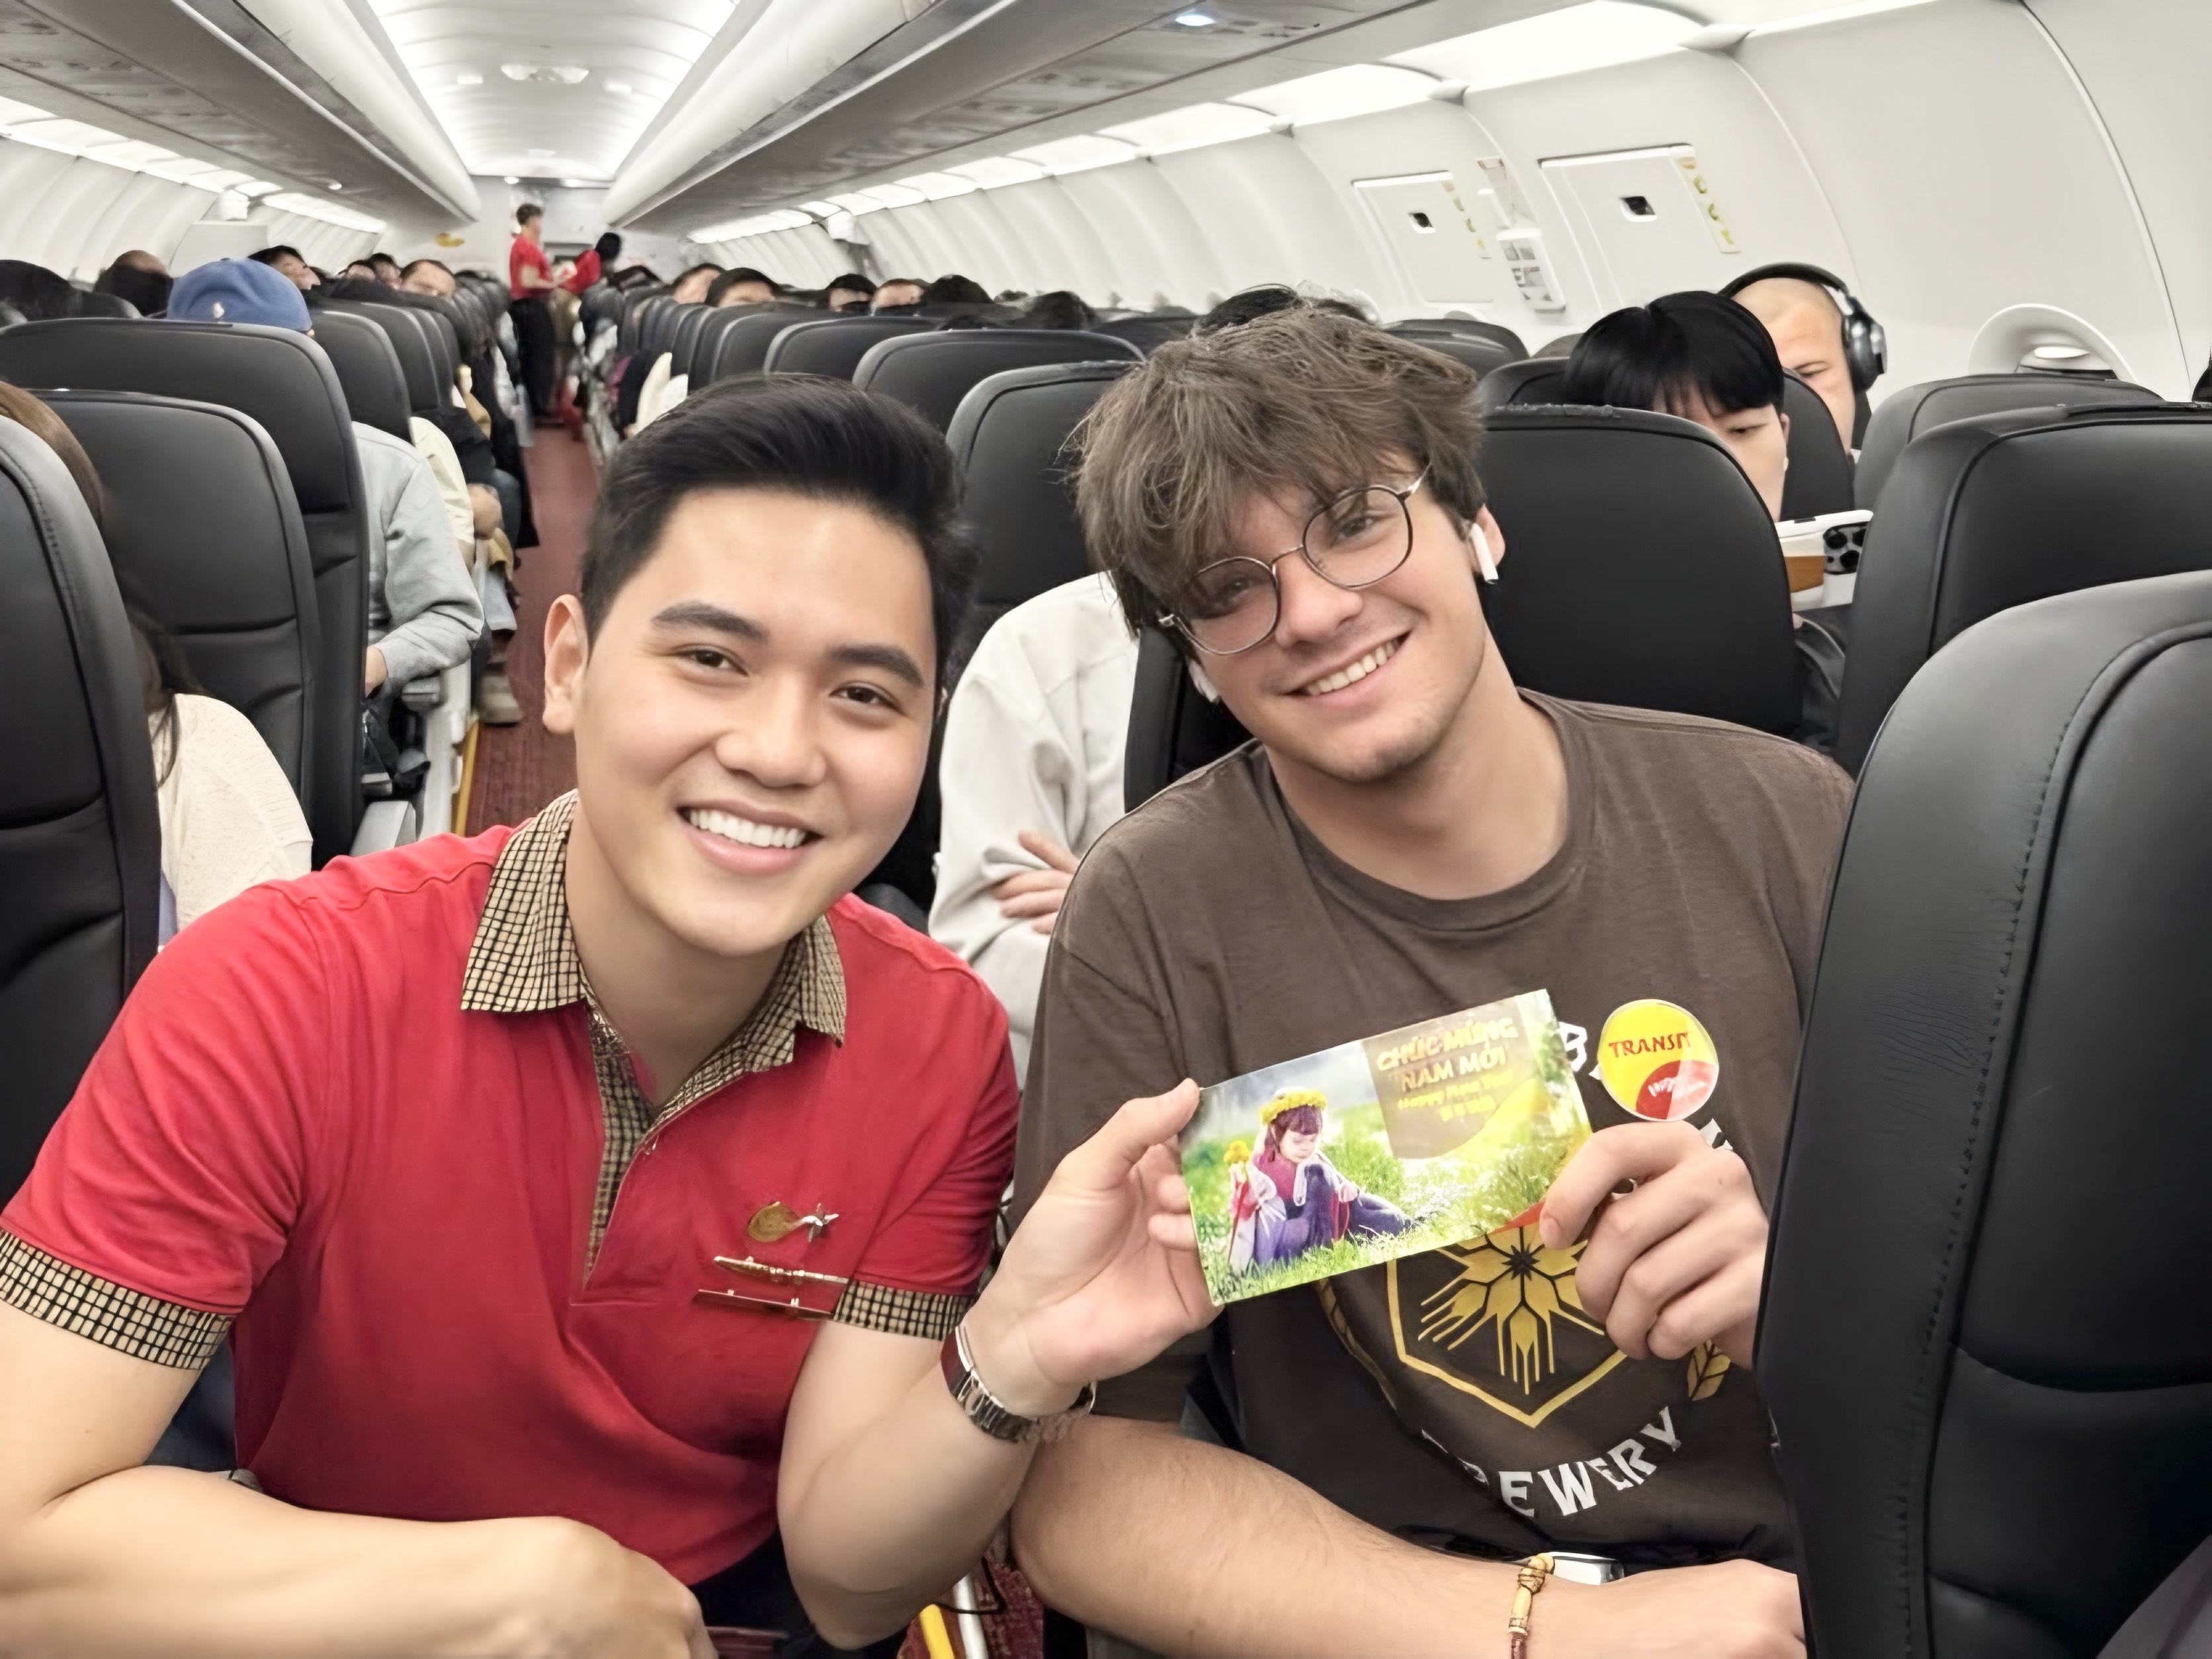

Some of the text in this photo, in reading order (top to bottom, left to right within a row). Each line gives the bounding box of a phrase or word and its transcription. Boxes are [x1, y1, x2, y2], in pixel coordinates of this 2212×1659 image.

[1377, 1036, 1441, 1071] CHÚC
[1608, 1031, 1692, 1058] TRANSIT
[1421, 1406, 1681, 1517] EWERY
